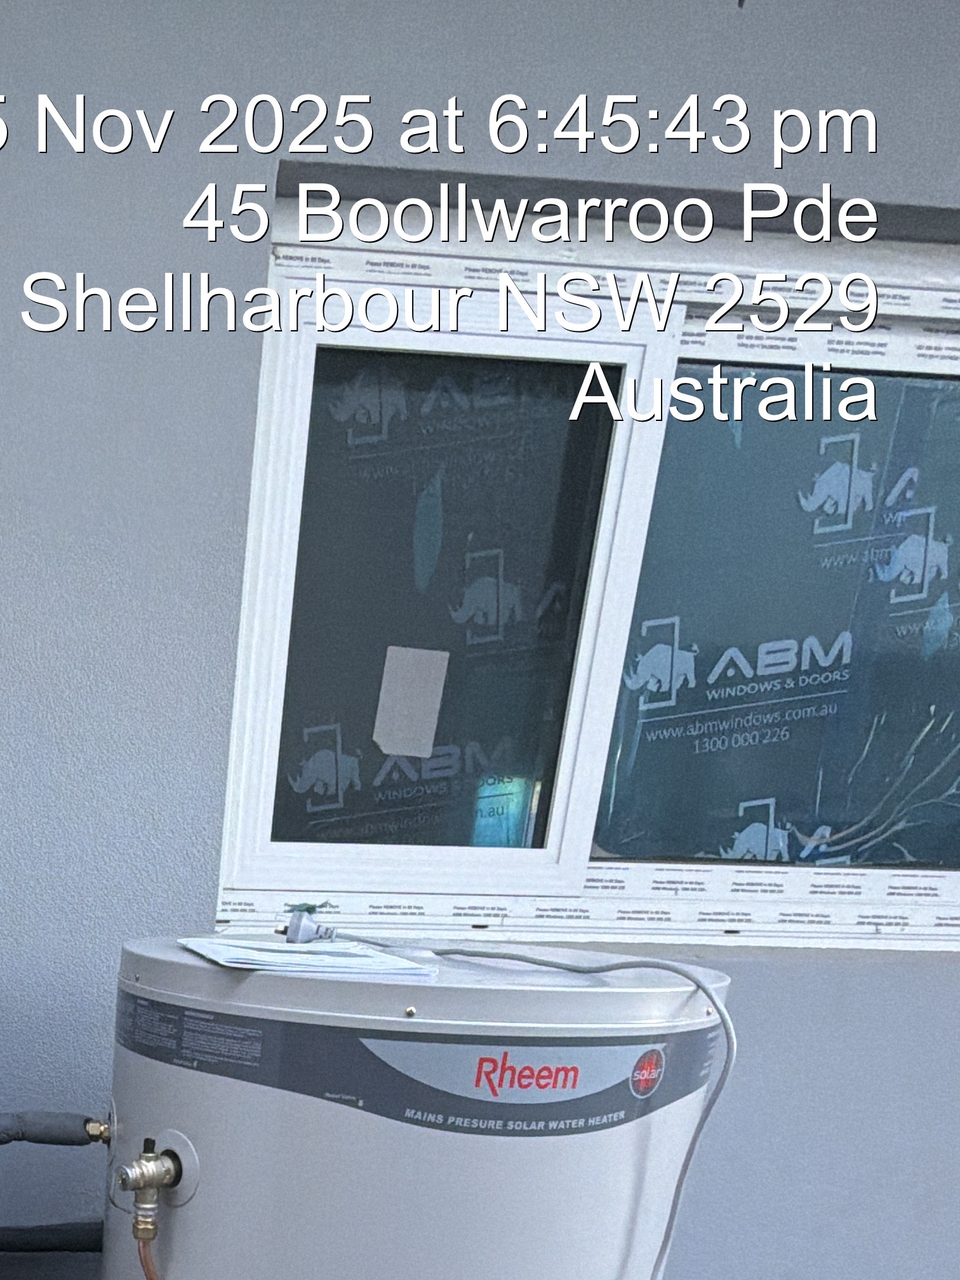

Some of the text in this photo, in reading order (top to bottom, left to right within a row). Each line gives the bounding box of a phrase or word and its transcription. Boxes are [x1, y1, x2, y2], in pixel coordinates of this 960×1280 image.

[706, 631, 853, 684] ABM
[706, 669, 851, 701] WINDOWS & DOORS
[645, 702, 838, 742] www.abmwindows.com.au
[693, 735, 728, 754] 1300
[762, 725, 791, 744] 226
[474, 1051, 580, 1098] Rheem
[632, 1066, 662, 1081] solar
[404, 1107, 626, 1131] MAINS PRESURE SOLAR WATER HEATER
